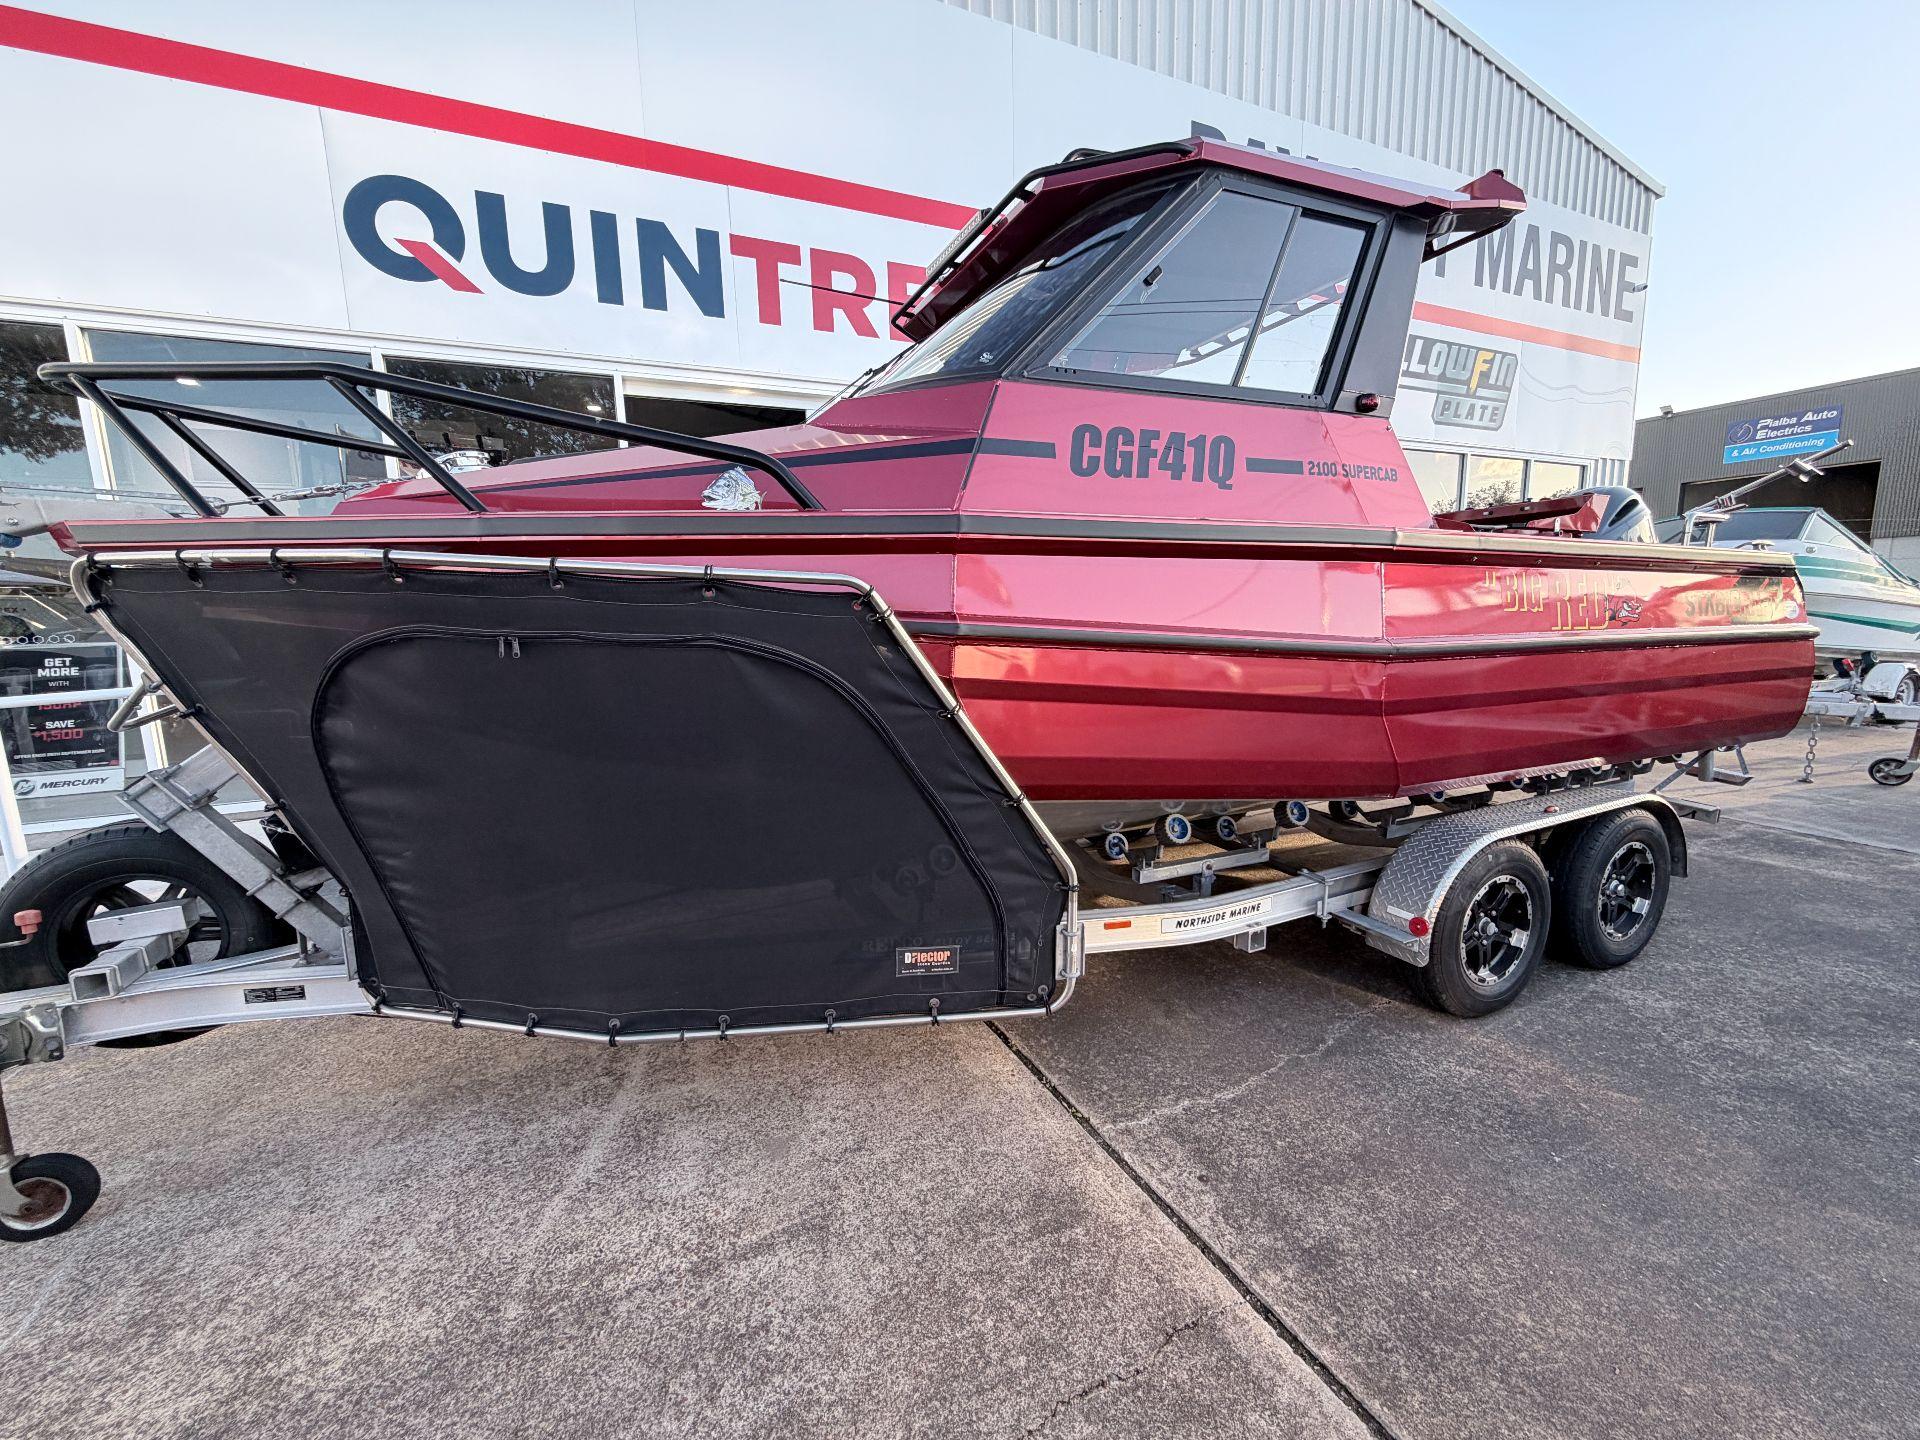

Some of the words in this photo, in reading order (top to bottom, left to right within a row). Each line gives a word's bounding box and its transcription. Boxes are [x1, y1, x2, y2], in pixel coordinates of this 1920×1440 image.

[1474, 219, 1639, 323] MARINE
[1401, 338, 1518, 395] LOWFIN
[1440, 400, 1500, 424] PLATE
[1756, 416, 1797, 430] Pialba
[1800, 409, 1838, 423] Auto
[1755, 424, 1813, 440] Electrics
[1069, 423, 1236, 490] CGF41Q
[1731, 449, 1739, 457] &
[1741, 448, 1756, 456] Air
[1760, 438, 1825, 454] Conditioning
[1307, 460, 1338, 477] 2100
[1341, 463, 1398, 482] SUPERCAB
[37, 667, 80, 678] MORE
[44, 657, 72, 667] GET
[45, 720, 76, 729] SAVE
[40, 777, 109, 790] MERCURY
[1175, 911, 1227, 929] NORTHSIDE
[1229, 903, 1261, 919] MARINE
